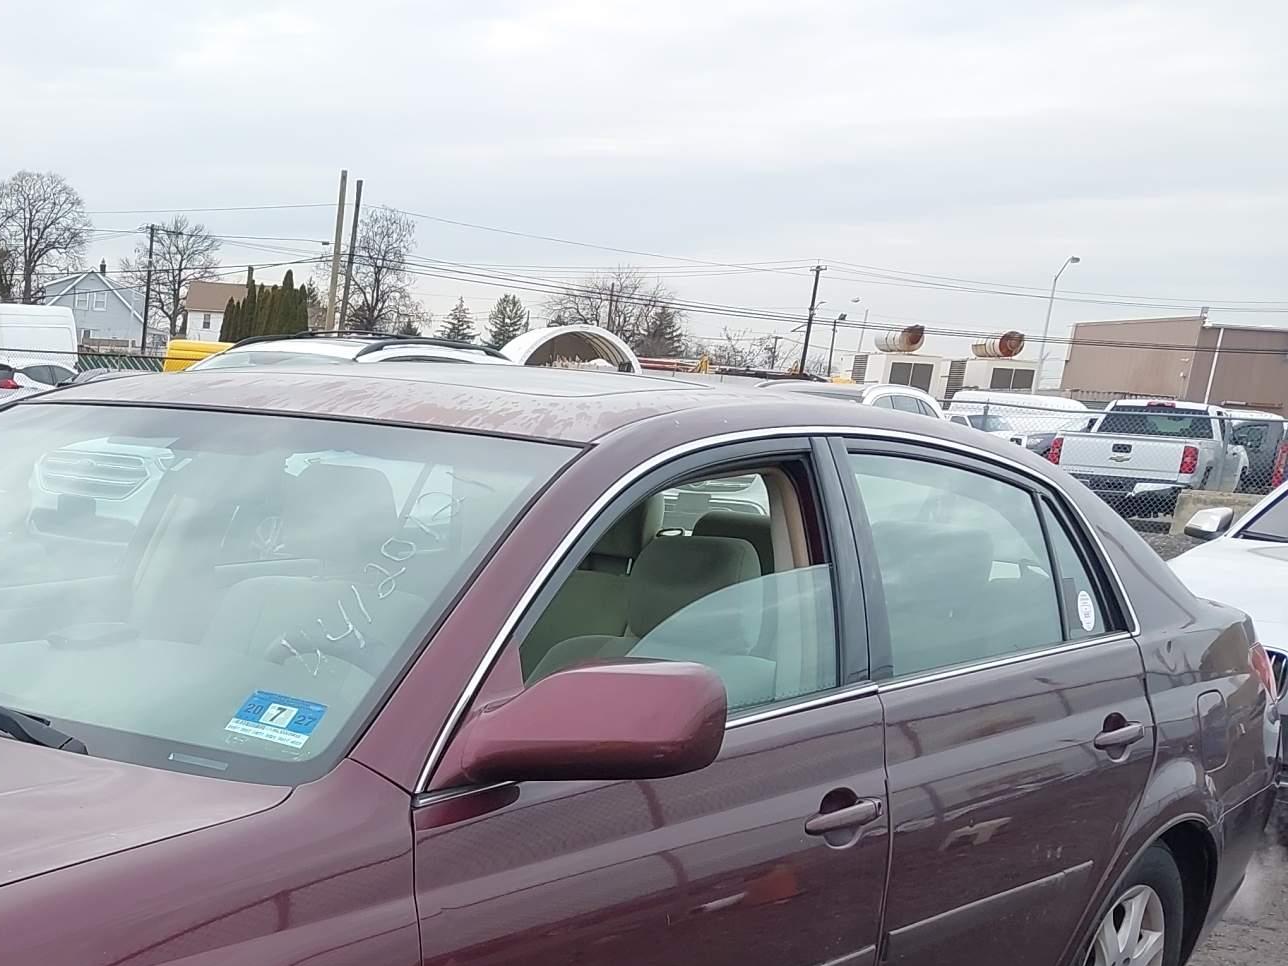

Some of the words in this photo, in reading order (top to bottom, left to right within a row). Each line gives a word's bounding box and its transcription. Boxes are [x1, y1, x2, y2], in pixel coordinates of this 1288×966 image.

[244, 703, 264, 714] 20
[269, 707, 287, 722] 7
[294, 715, 317, 728] 27
